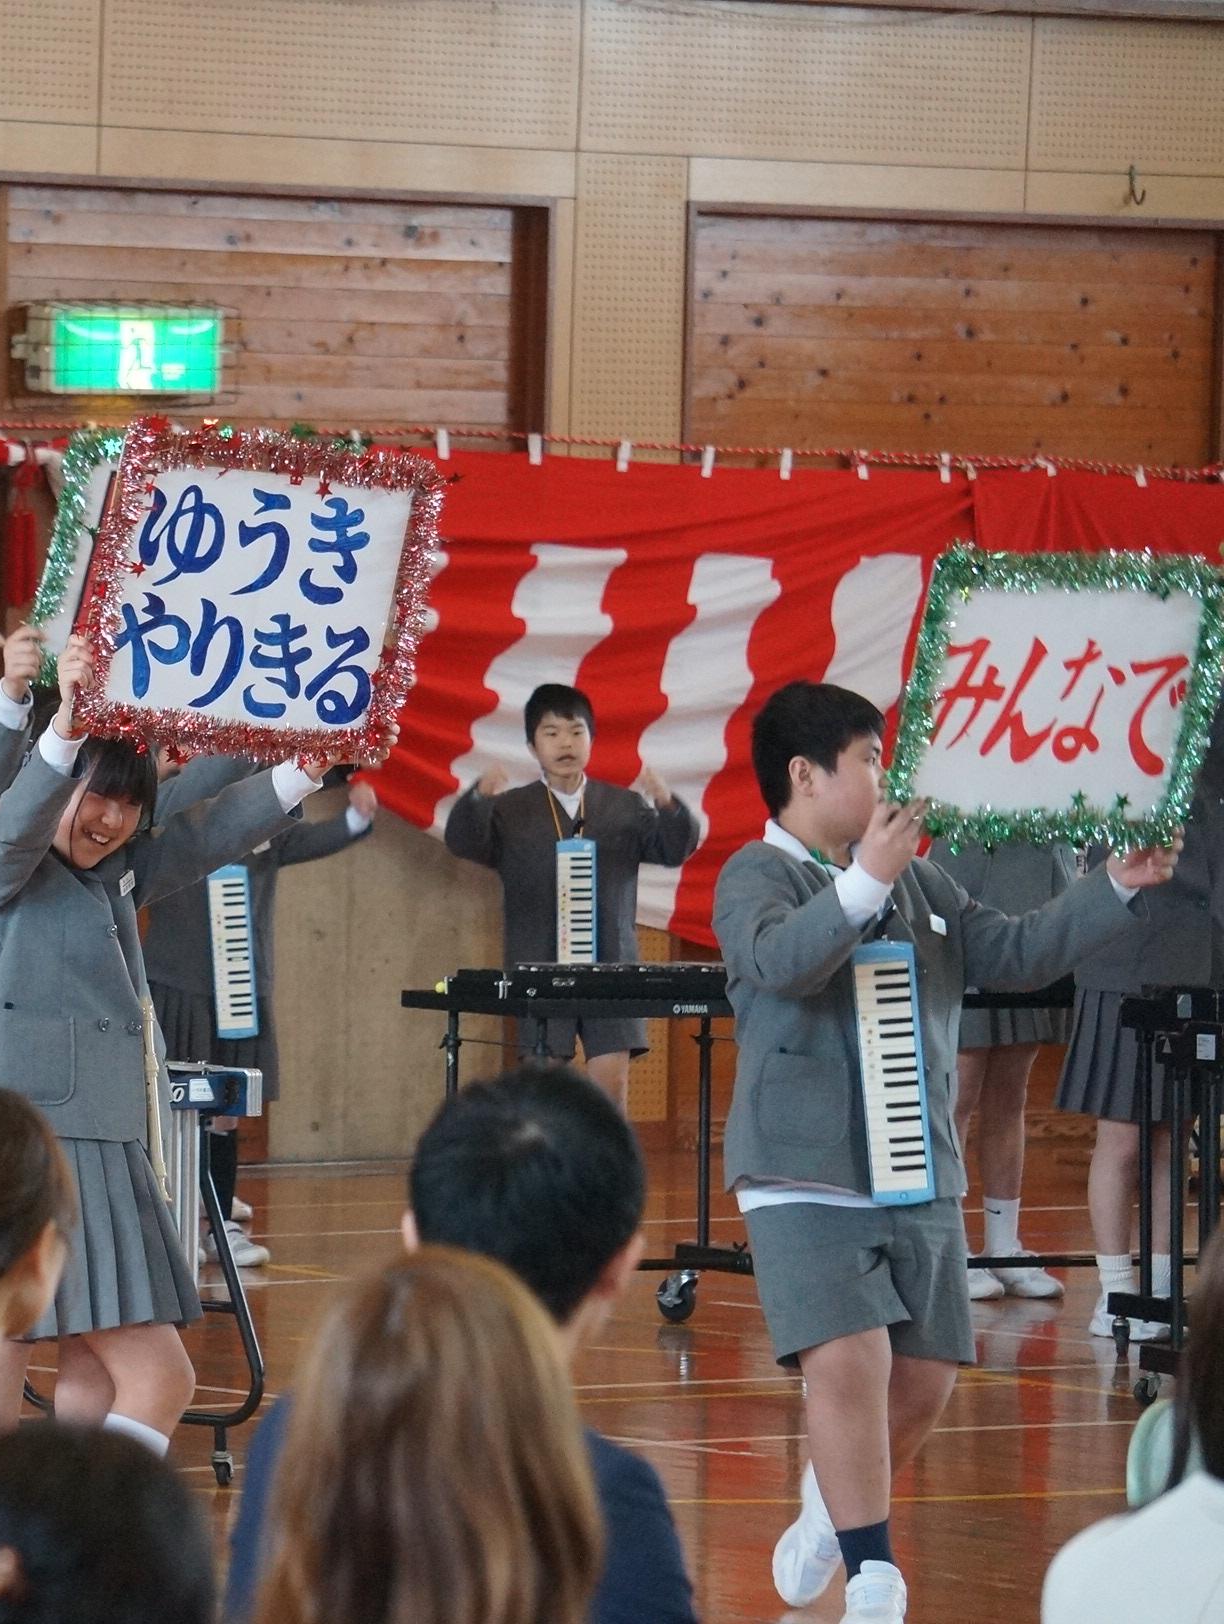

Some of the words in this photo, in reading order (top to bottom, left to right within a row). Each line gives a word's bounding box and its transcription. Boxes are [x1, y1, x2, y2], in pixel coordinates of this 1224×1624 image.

[138, 484, 371, 605] ゆうき
[114, 591, 372, 724] やりきる
[930, 635, 1190, 777] みんなで
[681, 1004, 708, 1014] YAMAHA
